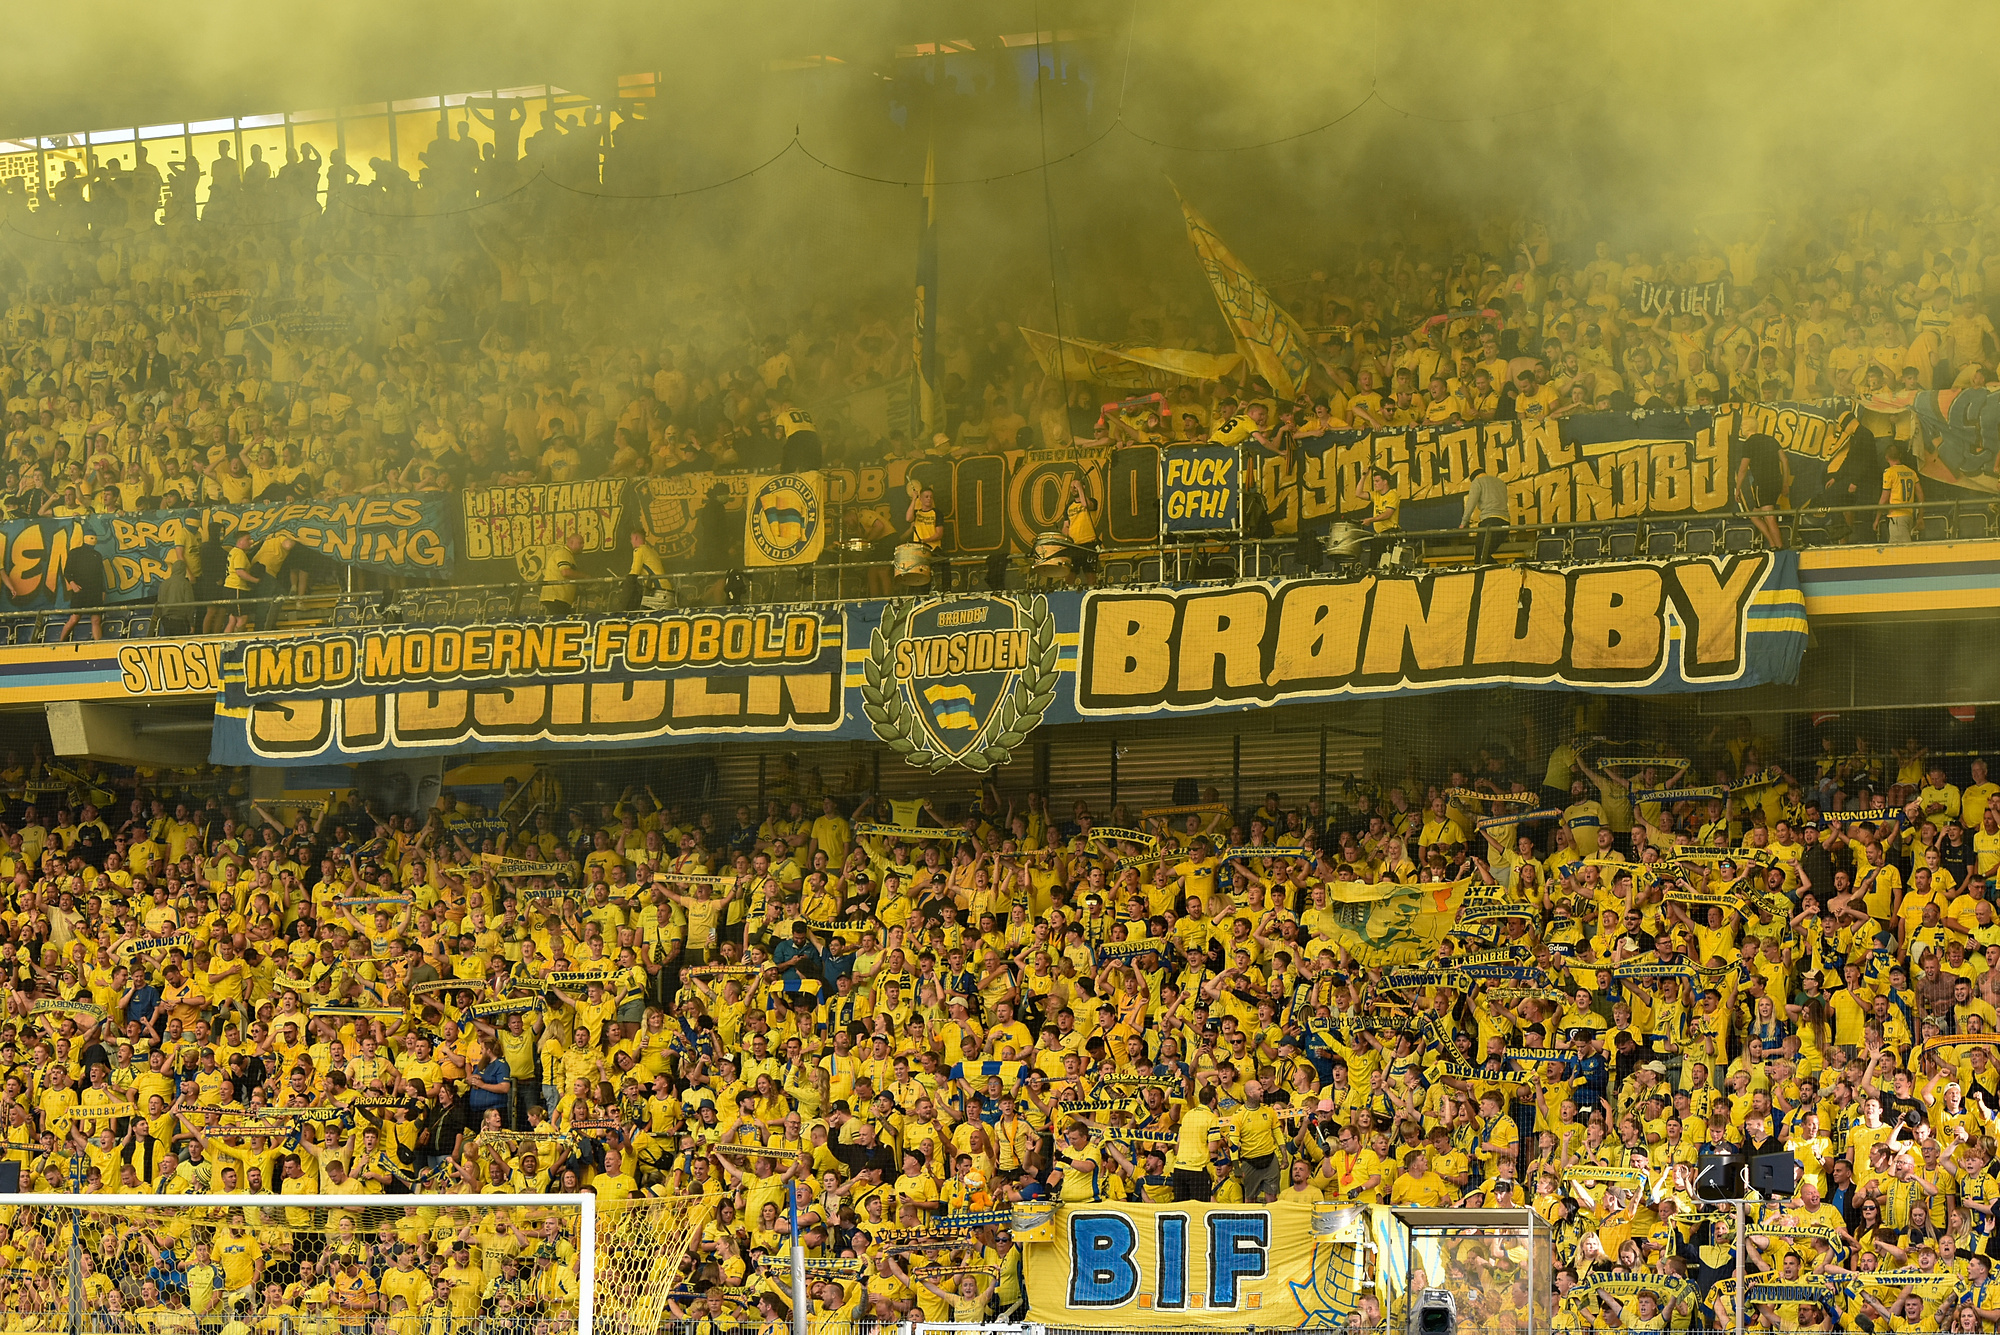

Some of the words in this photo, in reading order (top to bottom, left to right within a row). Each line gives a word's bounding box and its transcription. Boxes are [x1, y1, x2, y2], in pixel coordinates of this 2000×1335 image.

[1680, 281, 1725, 316] UEFA
[1167, 457, 1231, 488] FUCK
[1900, 478, 1914, 502] 19
[466, 487, 543, 517] FOREST
[548, 480, 625, 512] FAMILY
[768, 477, 815, 522] SYDSIDEN
[1167, 488, 1230, 519] GFH!
[753, 514, 798, 559] BRØNDBY
[938, 607, 988, 628] BRØNDBY
[1089, 557, 1769, 696] BRØNDBY
[247, 636, 354, 691] IMOD
[364, 623, 585, 683] MODERNE
[594, 614, 820, 667] FODBOLD
[896, 630, 1028, 678] SYDSIDEN
[1643, 788, 1698, 800] BRØNDBY
[1703, 788, 1713, 796] IF
[1823, 808, 1886, 822] BRØNDBY
[1889, 807, 1903, 818] IF
[876, 825, 945, 837] VESTEGNEN
[1681, 847, 1732, 856] BRØNDBY
[1738, 847, 1750, 856] IF
[507, 862, 554, 874] BRØNDBY
[557, 862, 567, 873] IF
[1484, 887, 1499, 897] IF
[1666, 892, 1692, 902] DANSKE
[1694, 894, 1721, 903] MESTRE
[1465, 904, 1530, 917] BRØNDBY
[1104, 938, 1159, 956] BRØNDBY
[1462, 951, 1509, 966] BRØNDBY
[552, 972, 611, 983] BRØNDBY
[613, 970, 625, 981] IF
[1522, 968, 1536, 979] IF
[1619, 966, 1670, 976] BRØNDBY
[1675, 966, 1687, 975] IF
[1390, 975, 1441, 990] BRØNDBY
[1447, 975, 1458, 986] IF
[1564, 1049, 1577, 1060] IF
[1446, 1062, 1510, 1081] BRØNDBY
[1512, 1071, 1527, 1082] IF
[355, 1096, 398, 1106] BRØNDBY
[400, 1096, 412, 1105] IF
[1118, 1099, 1131, 1108] IF
[70, 1106, 116, 1118] BRØNDBY
[121, 1105, 131, 1115] IF
[717, 1145, 753, 1156] BRØNDBY
[758, 1148, 796, 1159] STADION
[1567, 1168, 1629, 1179] BRØNDBY
[941, 1210, 1012, 1228] SYDSIDEN
[879, 1227, 969, 1241] VESTEGNEN
[1788, 1225, 1834, 1238] AGGER
[762, 1256, 837, 1270] BRØDBY
[843, 1257, 857, 1269] IF
[1067, 1211, 1271, 1311] B.I.F.
[1591, 1273, 1647, 1286] BRØNDBY
[1650, 1274, 1662, 1284] IF
[1725, 1274, 1763, 1294] BRNDBY
[1876, 1277, 1930, 1285] BRØNDBY
[1932, 1276, 1945, 1285] IF
[1750, 1286, 1810, 1301] BRØNDBY
